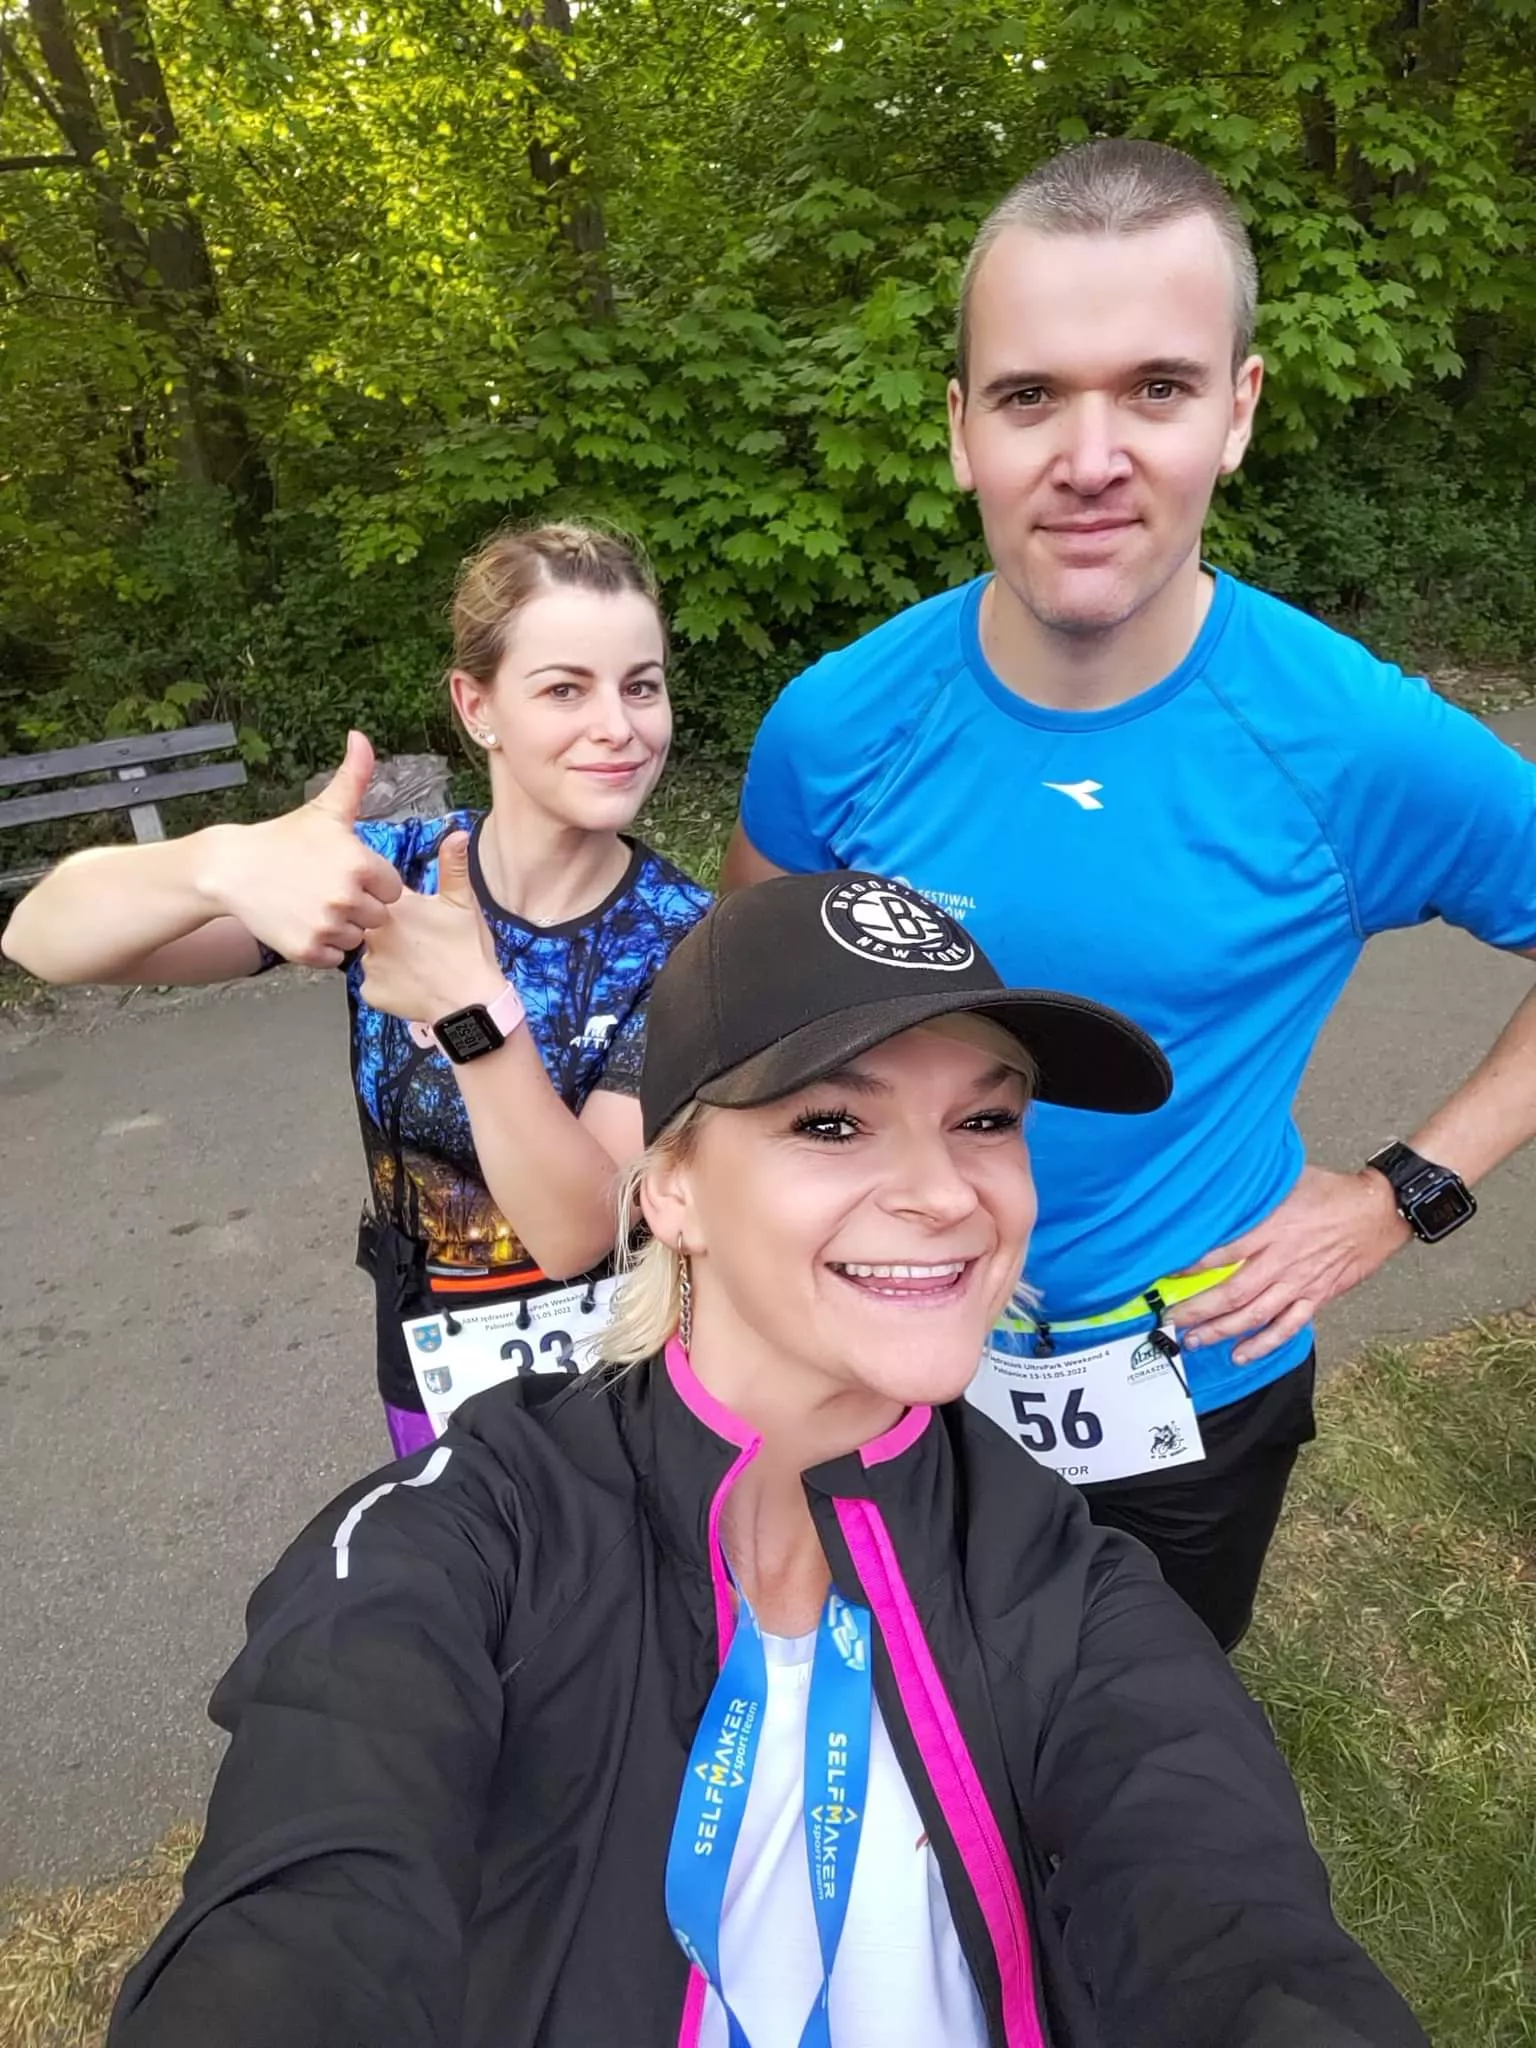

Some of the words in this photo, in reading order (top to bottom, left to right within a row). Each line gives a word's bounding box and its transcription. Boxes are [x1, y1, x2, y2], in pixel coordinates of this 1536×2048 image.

[856, 936, 909, 959] NEW
[921, 942, 965, 962] YORK
[1064, 1352, 1103, 1368] Weekend
[1009, 1387, 1104, 1453] 56
[1056, 1465, 1089, 1477] TOR
[733, 1733, 750, 1770] sport
[742, 1700, 759, 1733] team
[813, 1822, 823, 1859] sport
